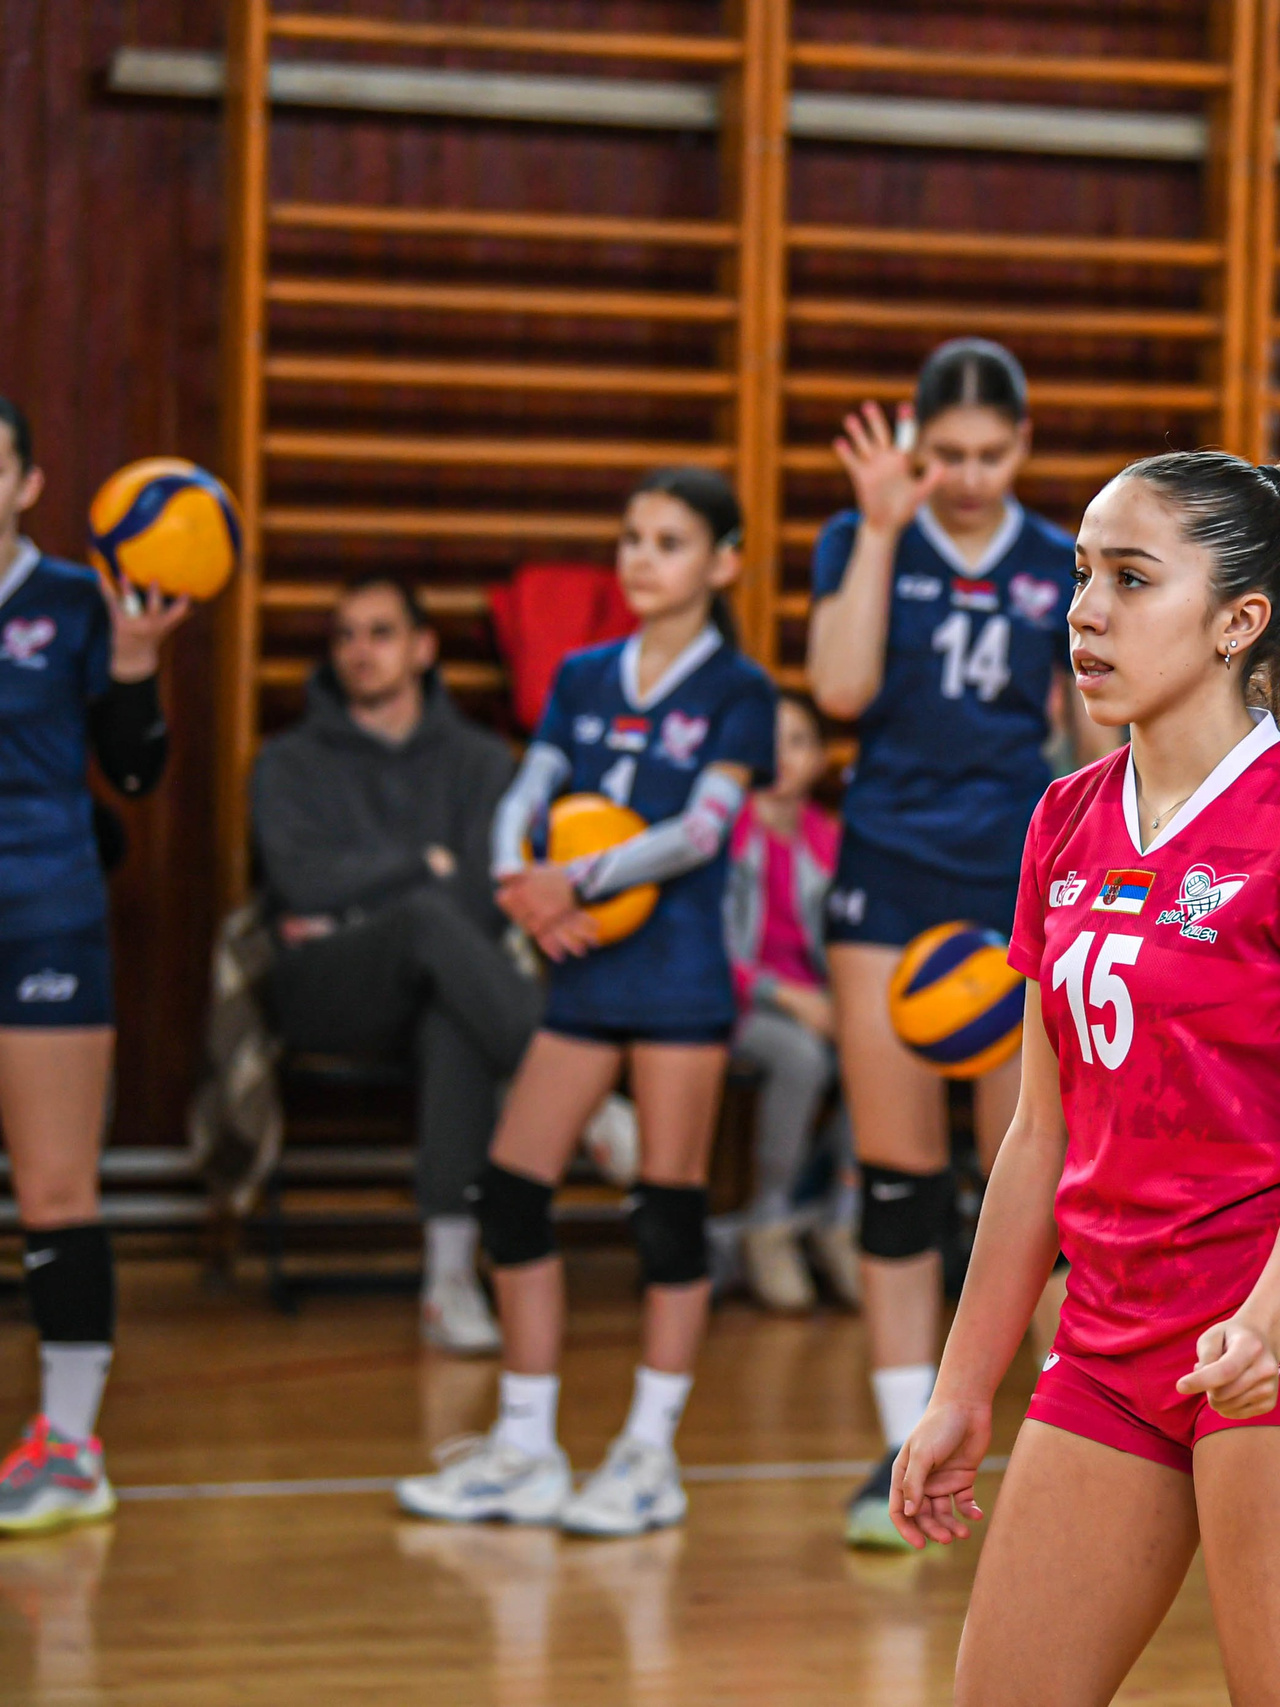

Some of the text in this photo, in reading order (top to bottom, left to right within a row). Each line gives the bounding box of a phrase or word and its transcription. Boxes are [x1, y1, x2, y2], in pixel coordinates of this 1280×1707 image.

[931, 612, 1011, 700] 14
[1155, 909, 1197, 924] BLOCK
[1180, 921, 1218, 943] VOLLEY
[1052, 931, 1144, 1071] 15
